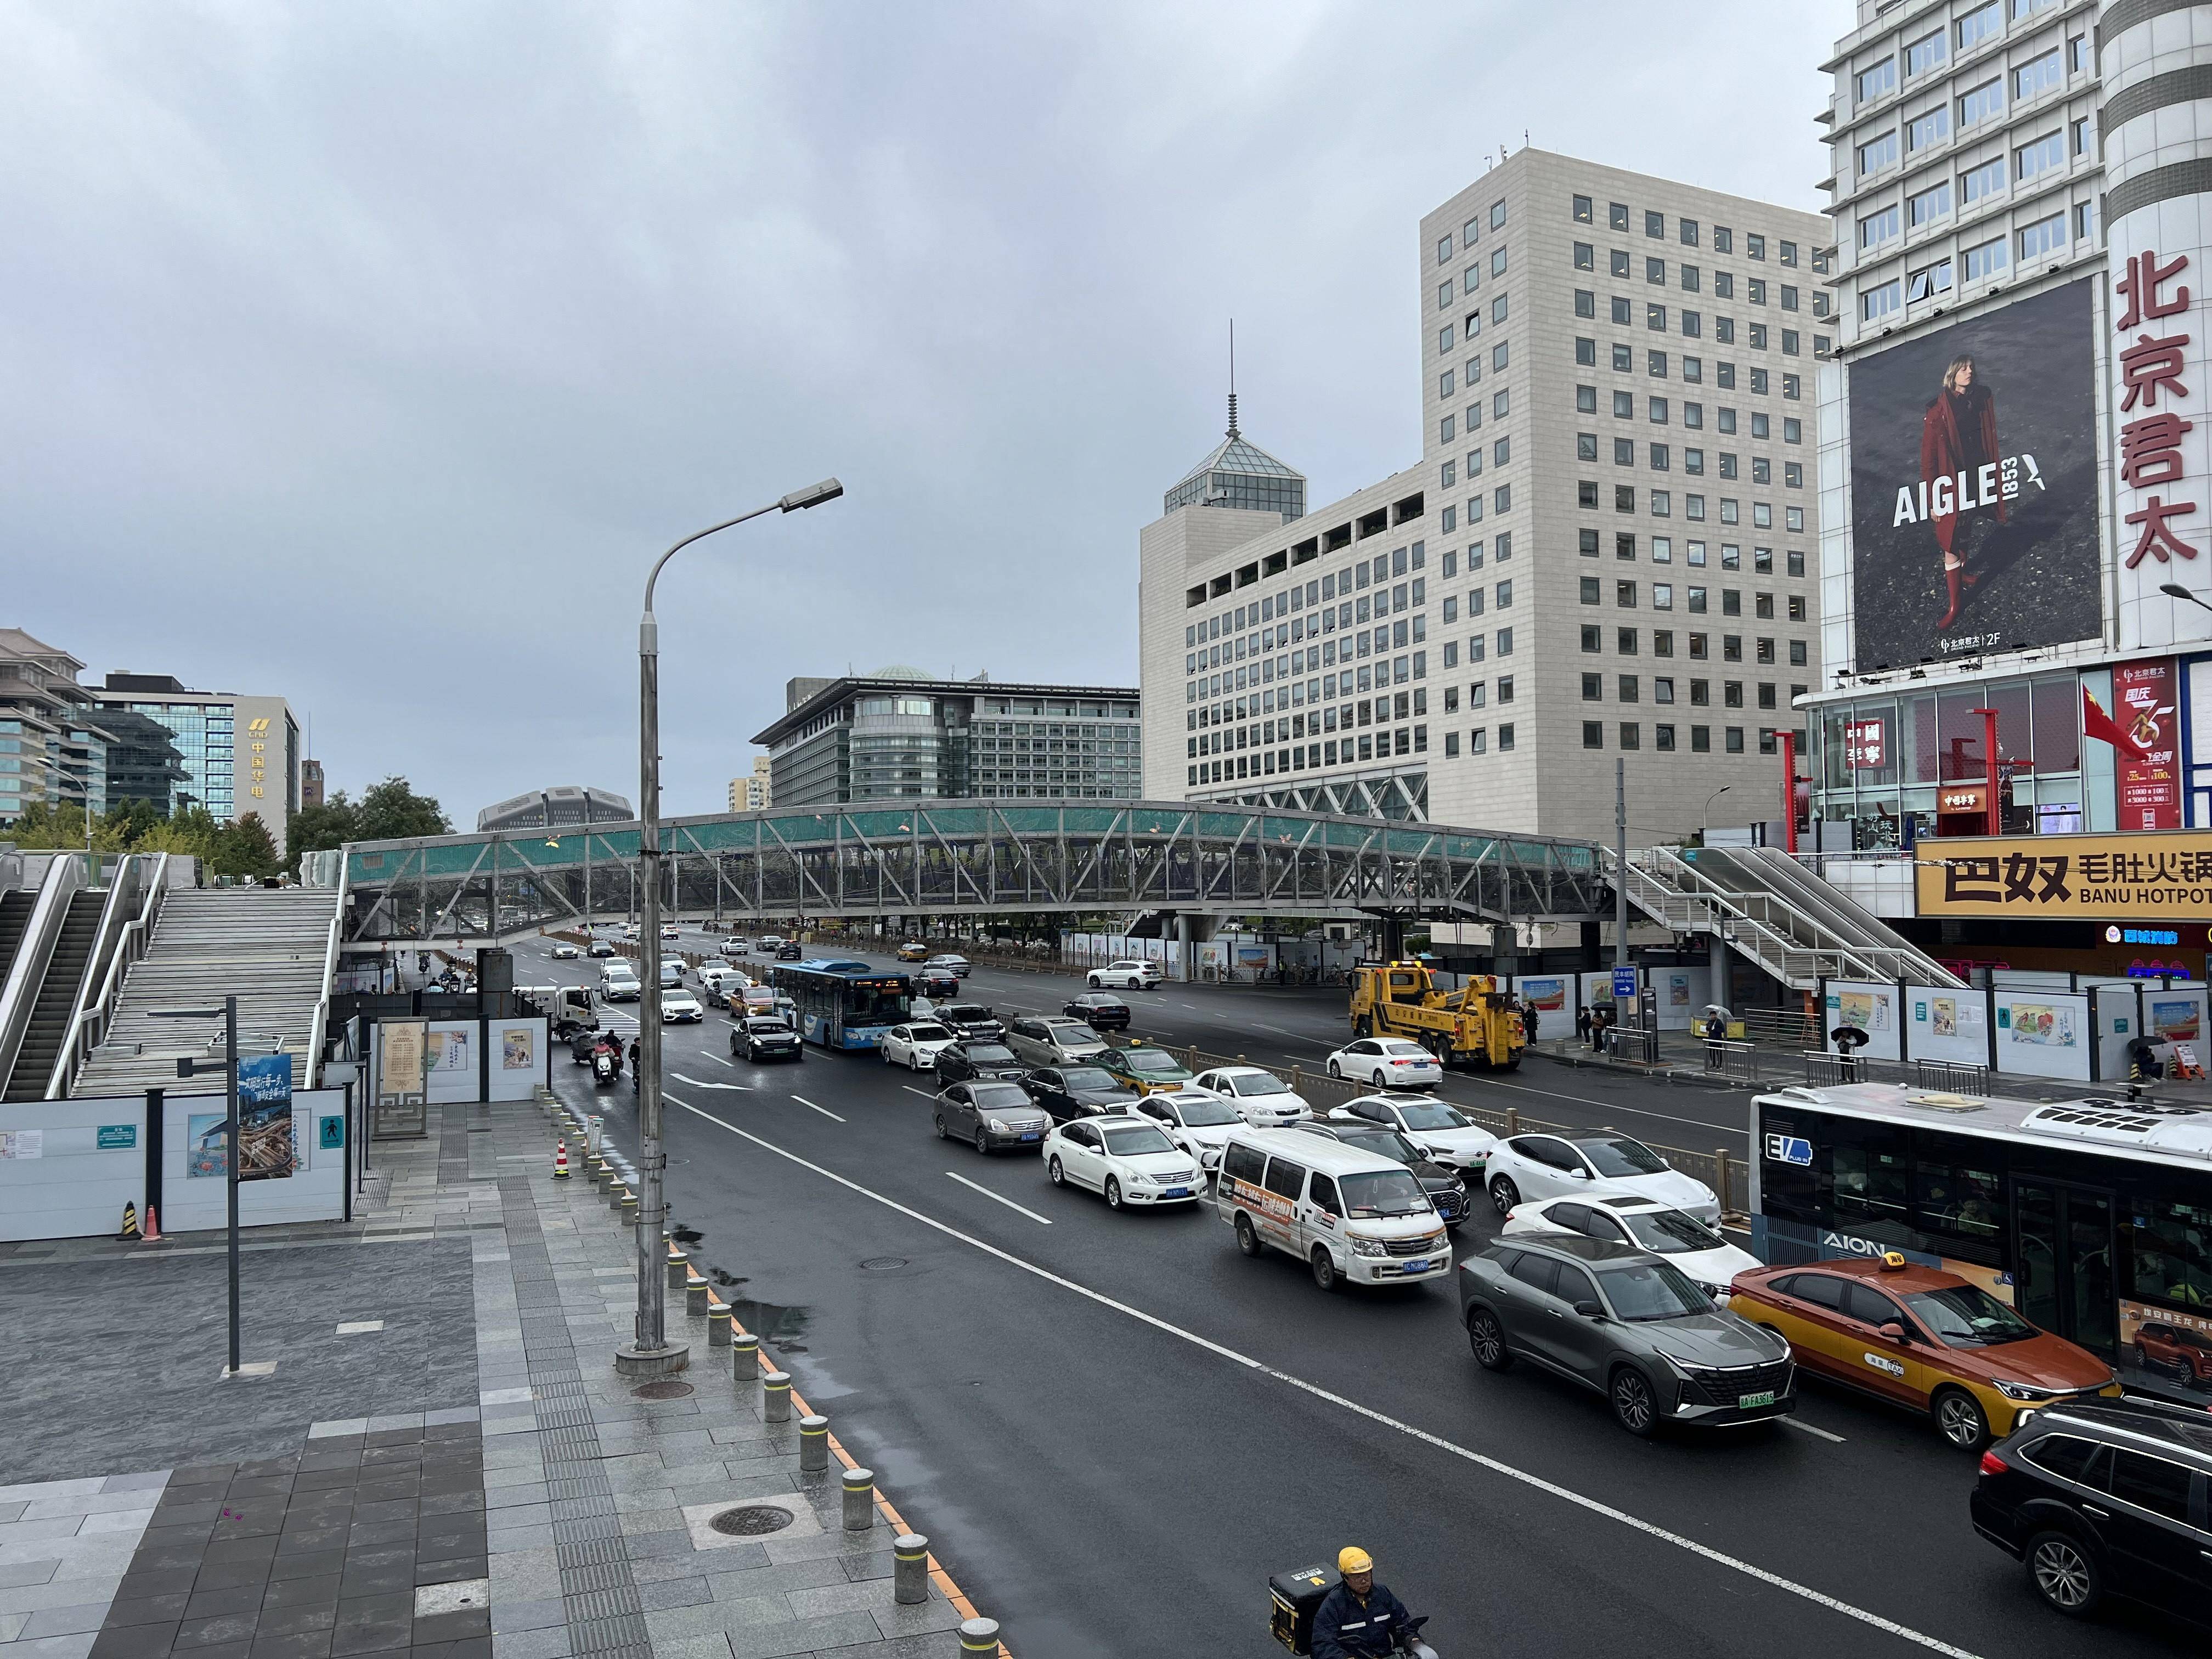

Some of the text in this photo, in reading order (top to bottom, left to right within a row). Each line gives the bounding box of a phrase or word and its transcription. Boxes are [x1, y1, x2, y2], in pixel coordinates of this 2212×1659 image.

[2116, 250, 2198, 569] 北京君太
[2001, 456, 2018, 500] 1853
[1893, 462, 1997, 527] AIGLE
[1951, 636, 1980, 648] 北京君太
[1987, 632, 2001, 646] 2F
[2134, 667, 2165, 677] 北京君太
[2125, 686, 2152, 702] 国庆
[2141, 751, 2173, 763] 金周
[251, 741, 265, 799] 中国华电
[1944, 851, 2212, 904] 巴奴 毛肚火锅
[2080, 888, 2212, 904] BANU HOTPOT
[1824, 1233, 1886, 1257] AION
[1889, 1364, 1903, 1374] TAXI
